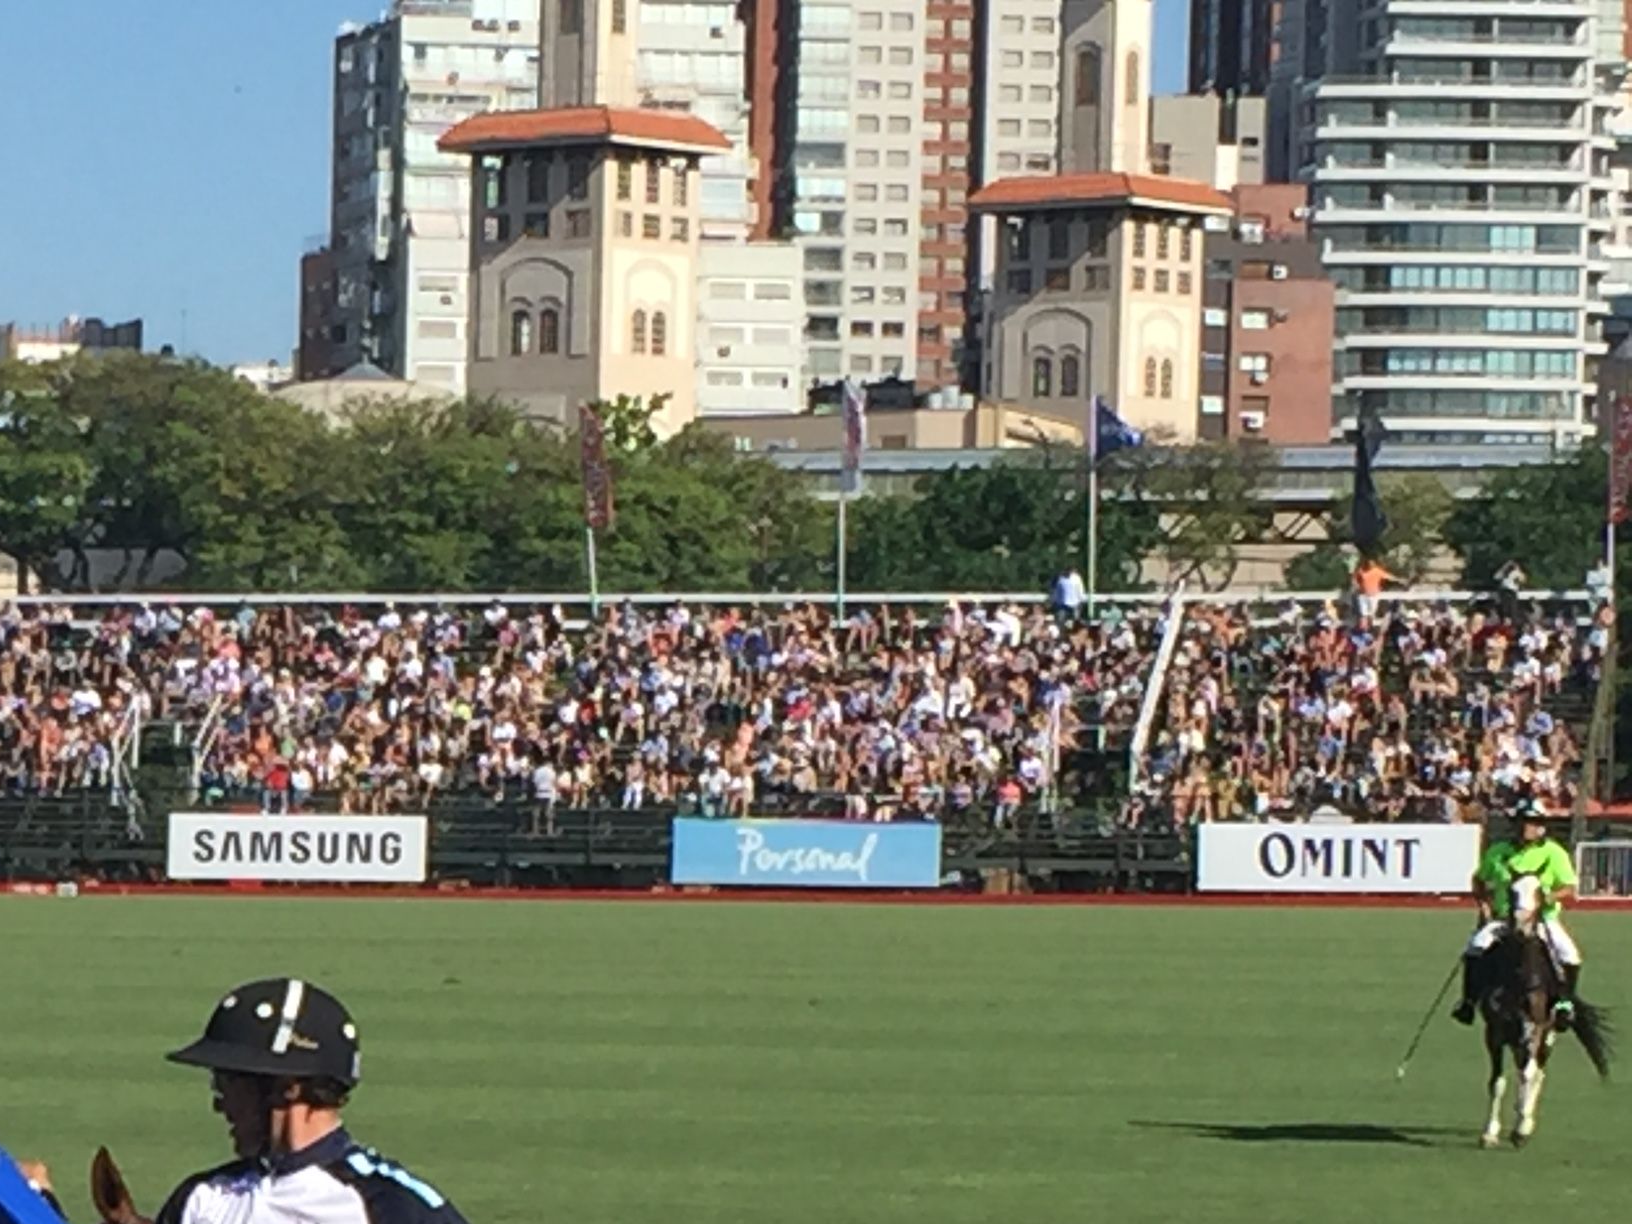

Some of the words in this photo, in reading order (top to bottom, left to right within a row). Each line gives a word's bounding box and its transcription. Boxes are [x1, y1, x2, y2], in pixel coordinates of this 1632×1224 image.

[193, 829, 402, 865] SAMSUNG
[736, 827, 878, 881] Personal
[1259, 832, 1420, 878] OMINT
